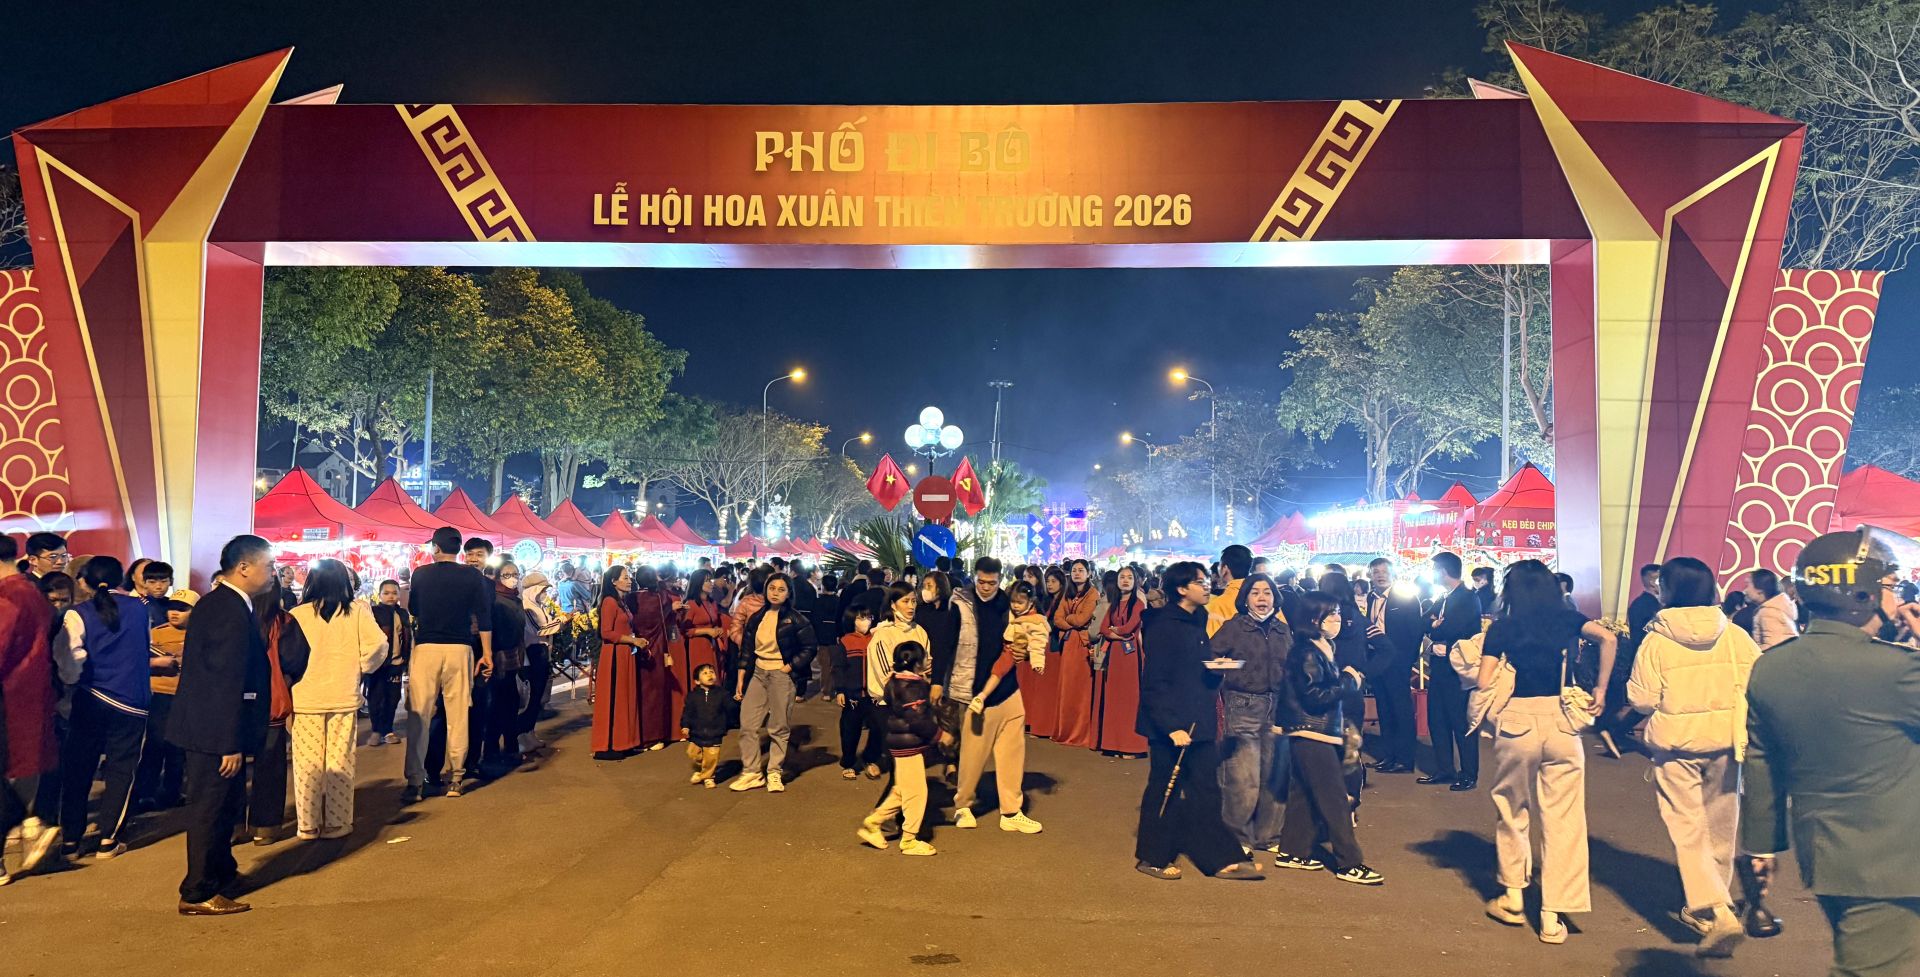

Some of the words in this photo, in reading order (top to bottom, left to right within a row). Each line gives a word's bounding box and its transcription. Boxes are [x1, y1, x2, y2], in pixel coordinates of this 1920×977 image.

[755, 116, 868, 171] PHỐ
[884, 132, 938, 171] ĐI
[593, 182, 629, 225] LỄ
[640, 187, 693, 233] HỘI
[703, 194, 767, 226] HOA
[776, 188, 864, 227] XUÂN
[976, 187, 1103, 227] TRƯỜNG
[1113, 193, 1192, 227] 2026
[1804, 563, 1858, 585] CSTT
